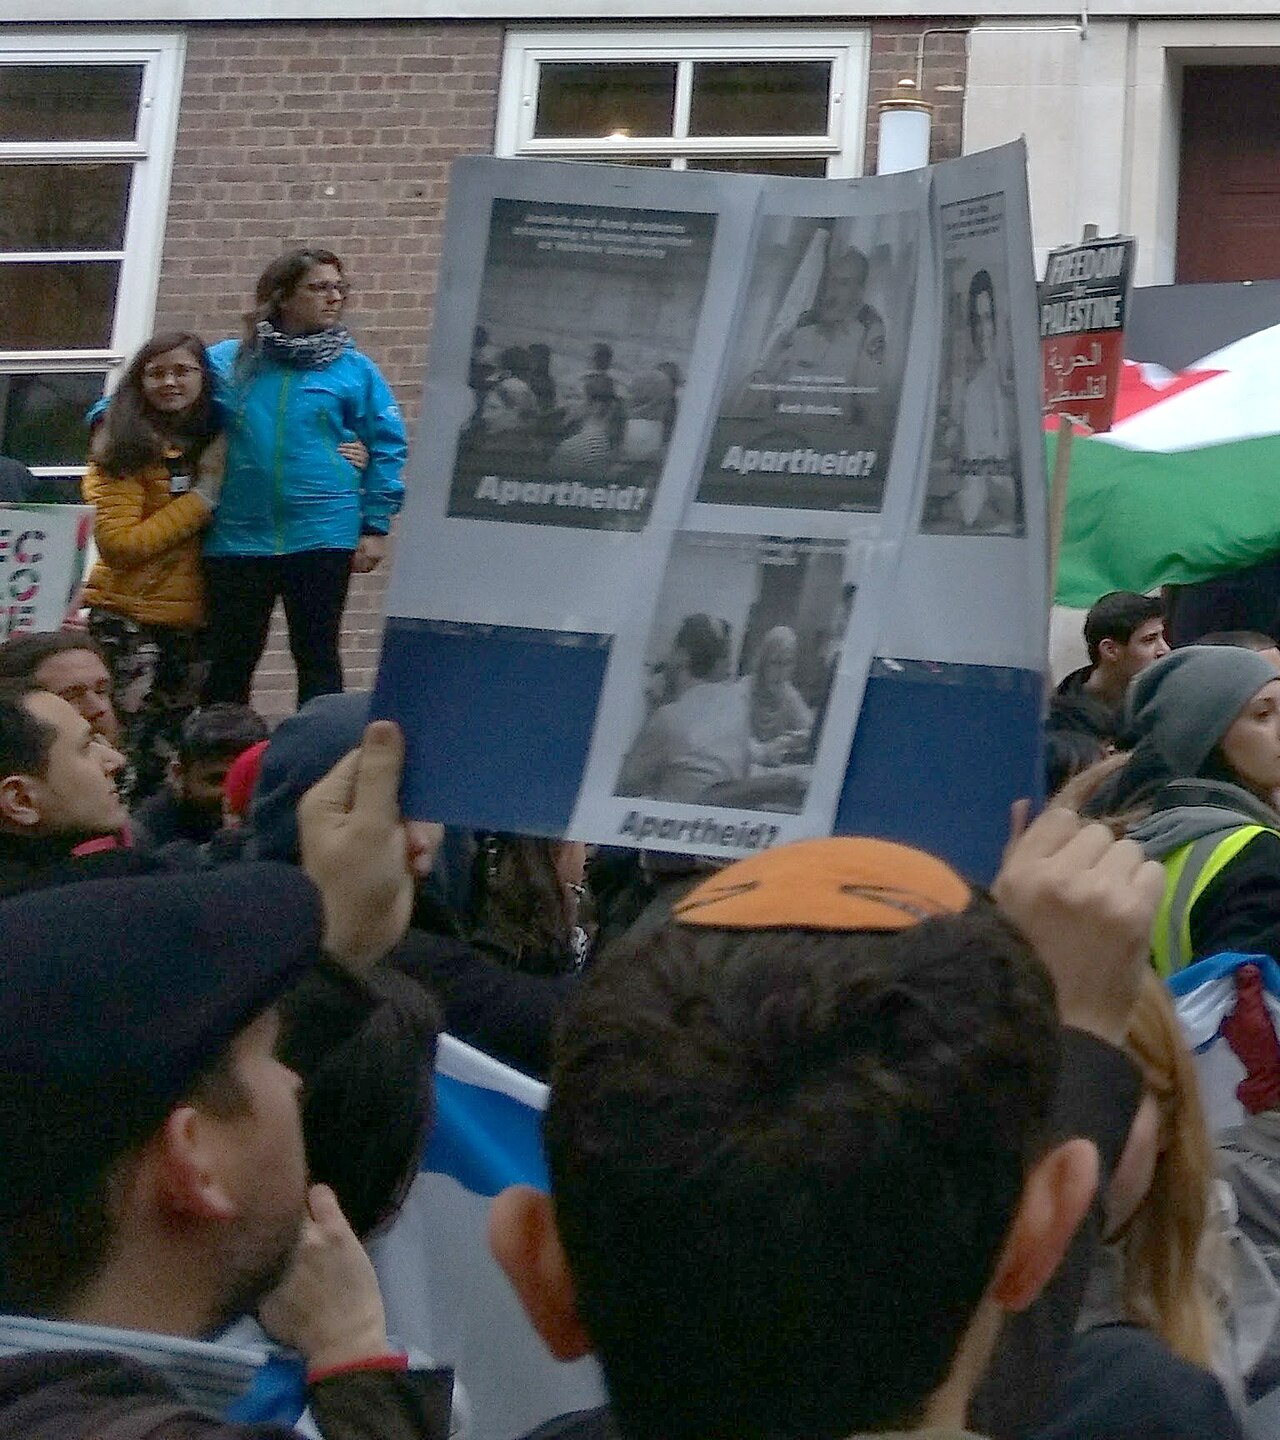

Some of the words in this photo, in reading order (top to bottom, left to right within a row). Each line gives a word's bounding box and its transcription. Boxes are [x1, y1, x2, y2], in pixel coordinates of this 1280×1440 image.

[720, 445, 878, 477] Apartheid?
[474, 475, 647, 511] Apartheid?
[617, 810, 781, 849] Apartheid?
